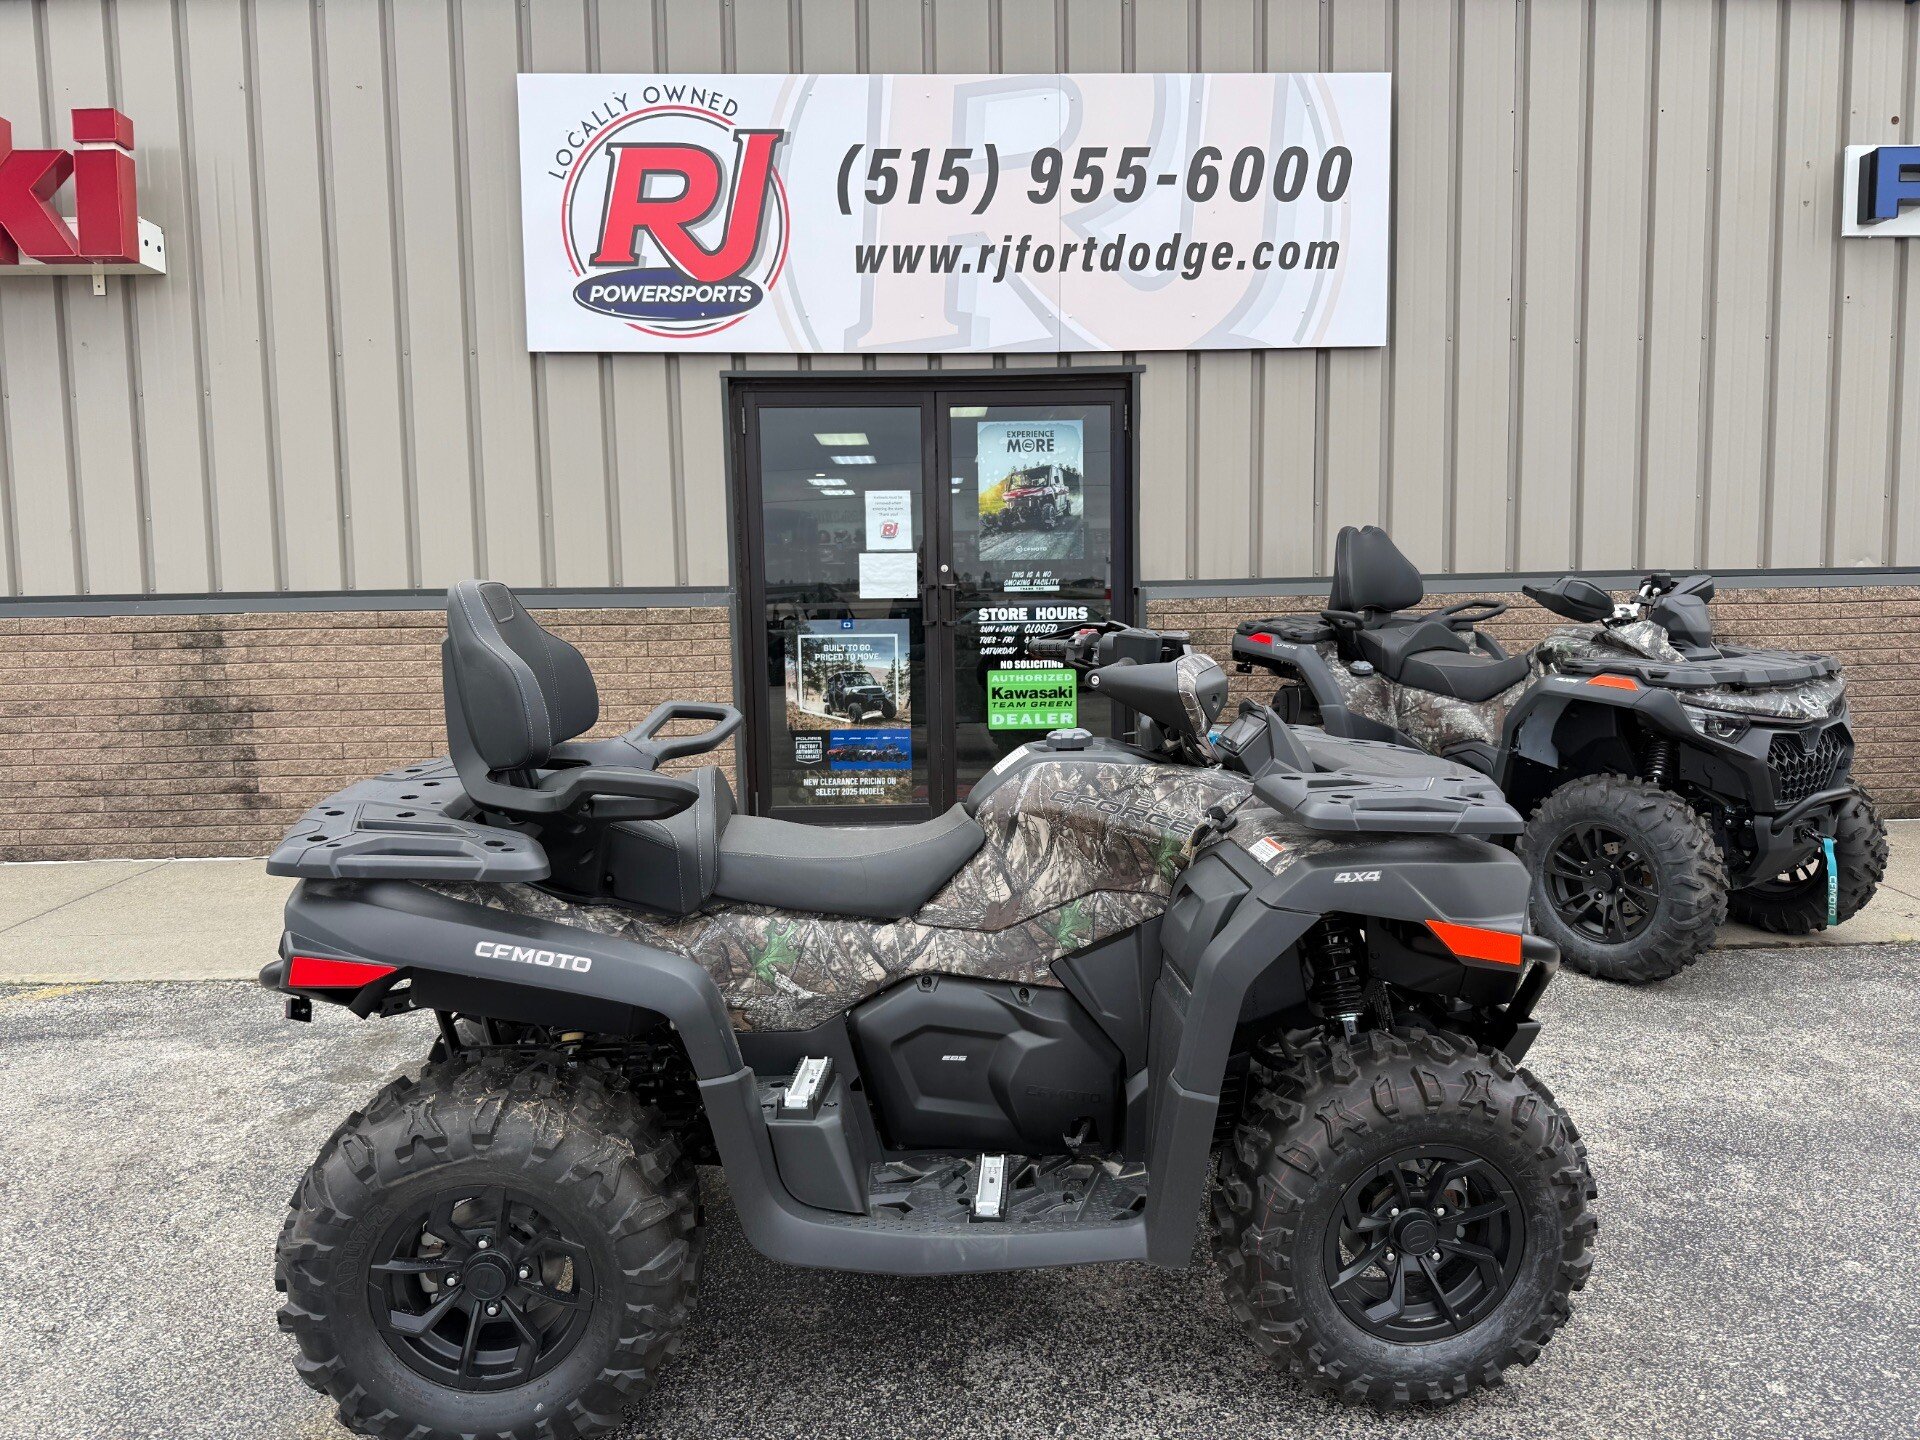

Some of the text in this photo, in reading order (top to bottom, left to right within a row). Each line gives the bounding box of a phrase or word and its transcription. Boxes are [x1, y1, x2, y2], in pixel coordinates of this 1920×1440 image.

[548, 84, 738, 180] LOCALLY OWNED
[837, 144, 1353, 215] (515) 955-6000
[589, 129, 785, 282] RJ
[855, 233, 1340, 283] www.rjfortdodge.com
[589, 285, 752, 303] POWERSPORTS
[1006, 430, 1055, 438] EXPERIENCE
[1042, 570, 1052, 578] NO
[1032, 578, 1060, 586] FACILITY
[978, 606, 1088, 620] STORE HOURS
[980, 625, 996, 633] SUN
[1000, 624, 1019, 633] MON
[1024, 623, 1058, 633] CLOSED
[979, 636, 997, 644] TUES
[1002, 636, 1015, 644] FRI
[823, 644, 846, 652] BUILT
[979, 646, 1018, 655] SATURDAY
[814, 652, 881, 661] PRICED TO MOVE.
[1000, 660, 1013, 669] NO
[992, 673, 1074, 682] AUTHORIZED
[992, 685, 1073, 699] Kawasaki
[992, 712, 1074, 725] DEALER
[803, 777, 897, 786] NEW CLEARANCE PRICING ON
[815, 787, 885, 796] SELECT 2025 MODELS
[1050, 790, 1197, 835] CFORCE
[1334, 870, 1382, 883] 4X4
[1827, 875, 1837, 917] CFMOTO
[475, 941, 592, 973] CFMOTO
